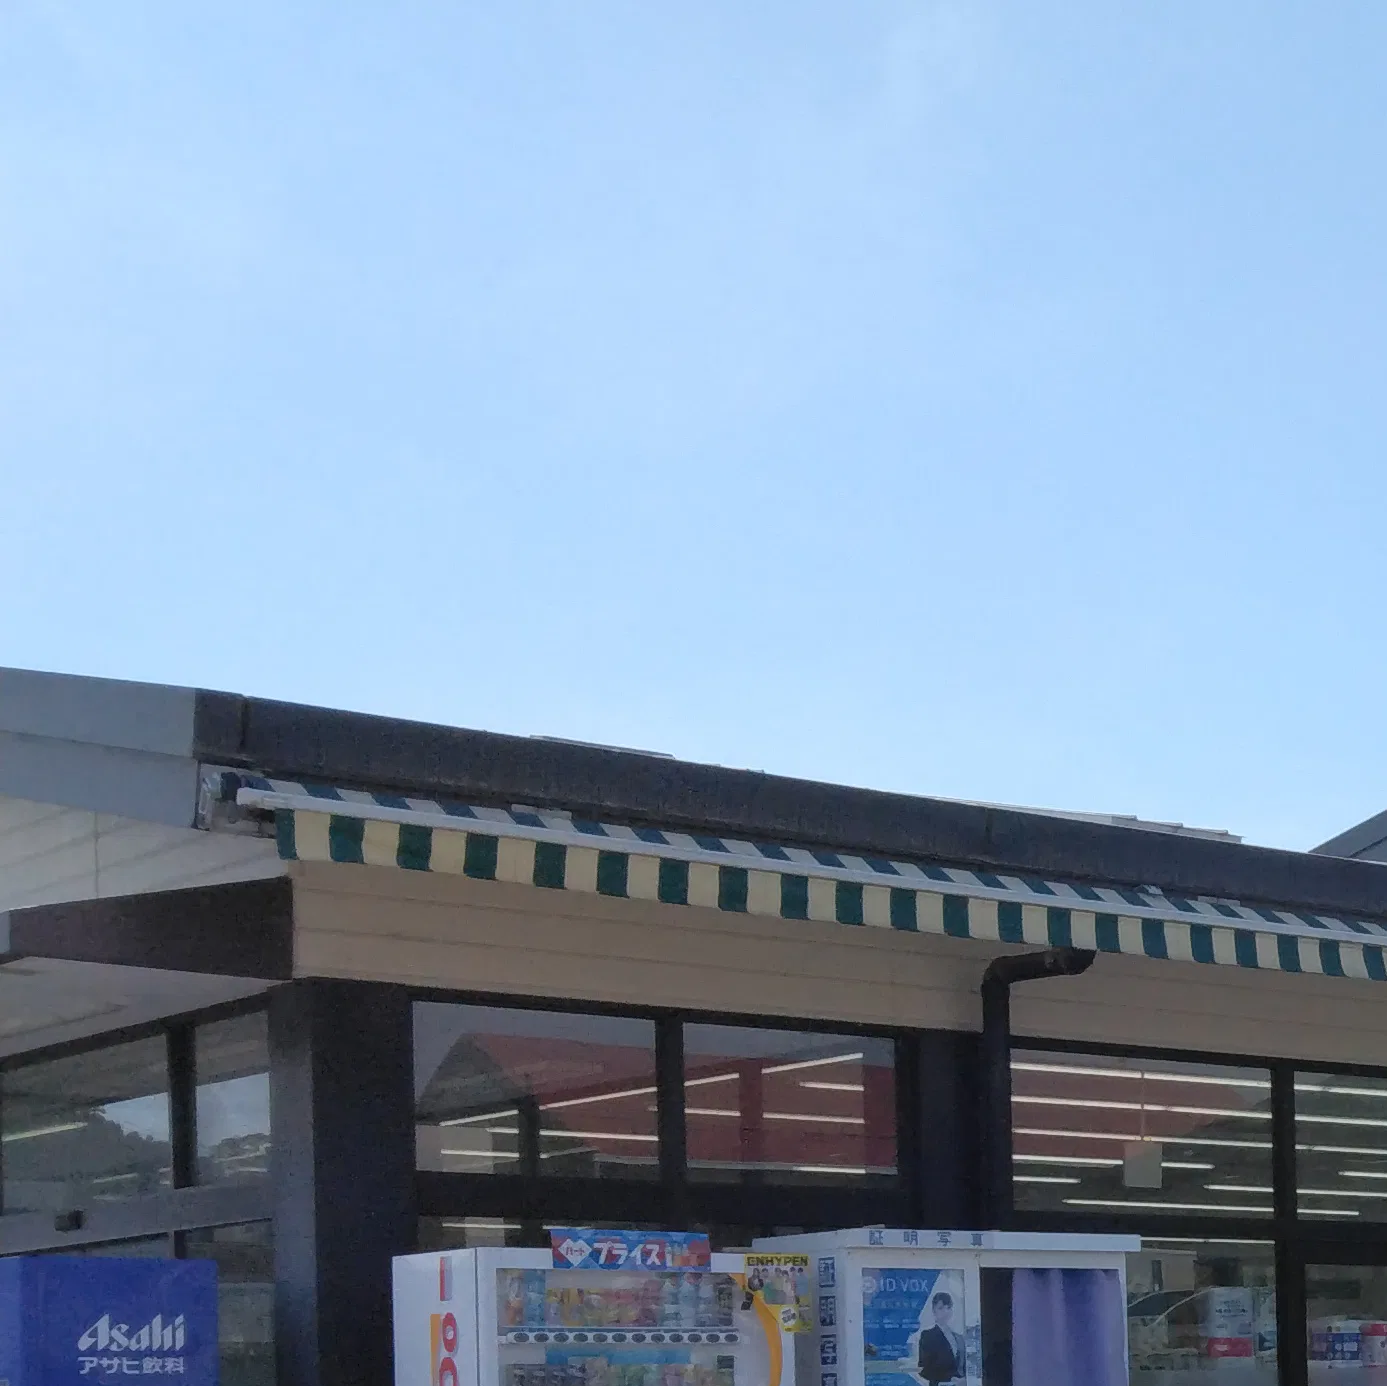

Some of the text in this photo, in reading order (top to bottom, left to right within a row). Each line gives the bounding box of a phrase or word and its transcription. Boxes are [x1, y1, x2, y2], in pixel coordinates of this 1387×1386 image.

[869, 1229, 984, 1247] 証明写真
[593, 1240, 661, 1265] プライス
[746, 1255, 809, 1267] ENHYPEN
[77, 1313, 186, 1352] Asahi
[77, 1356, 186, 1375] アサヒ飲料
